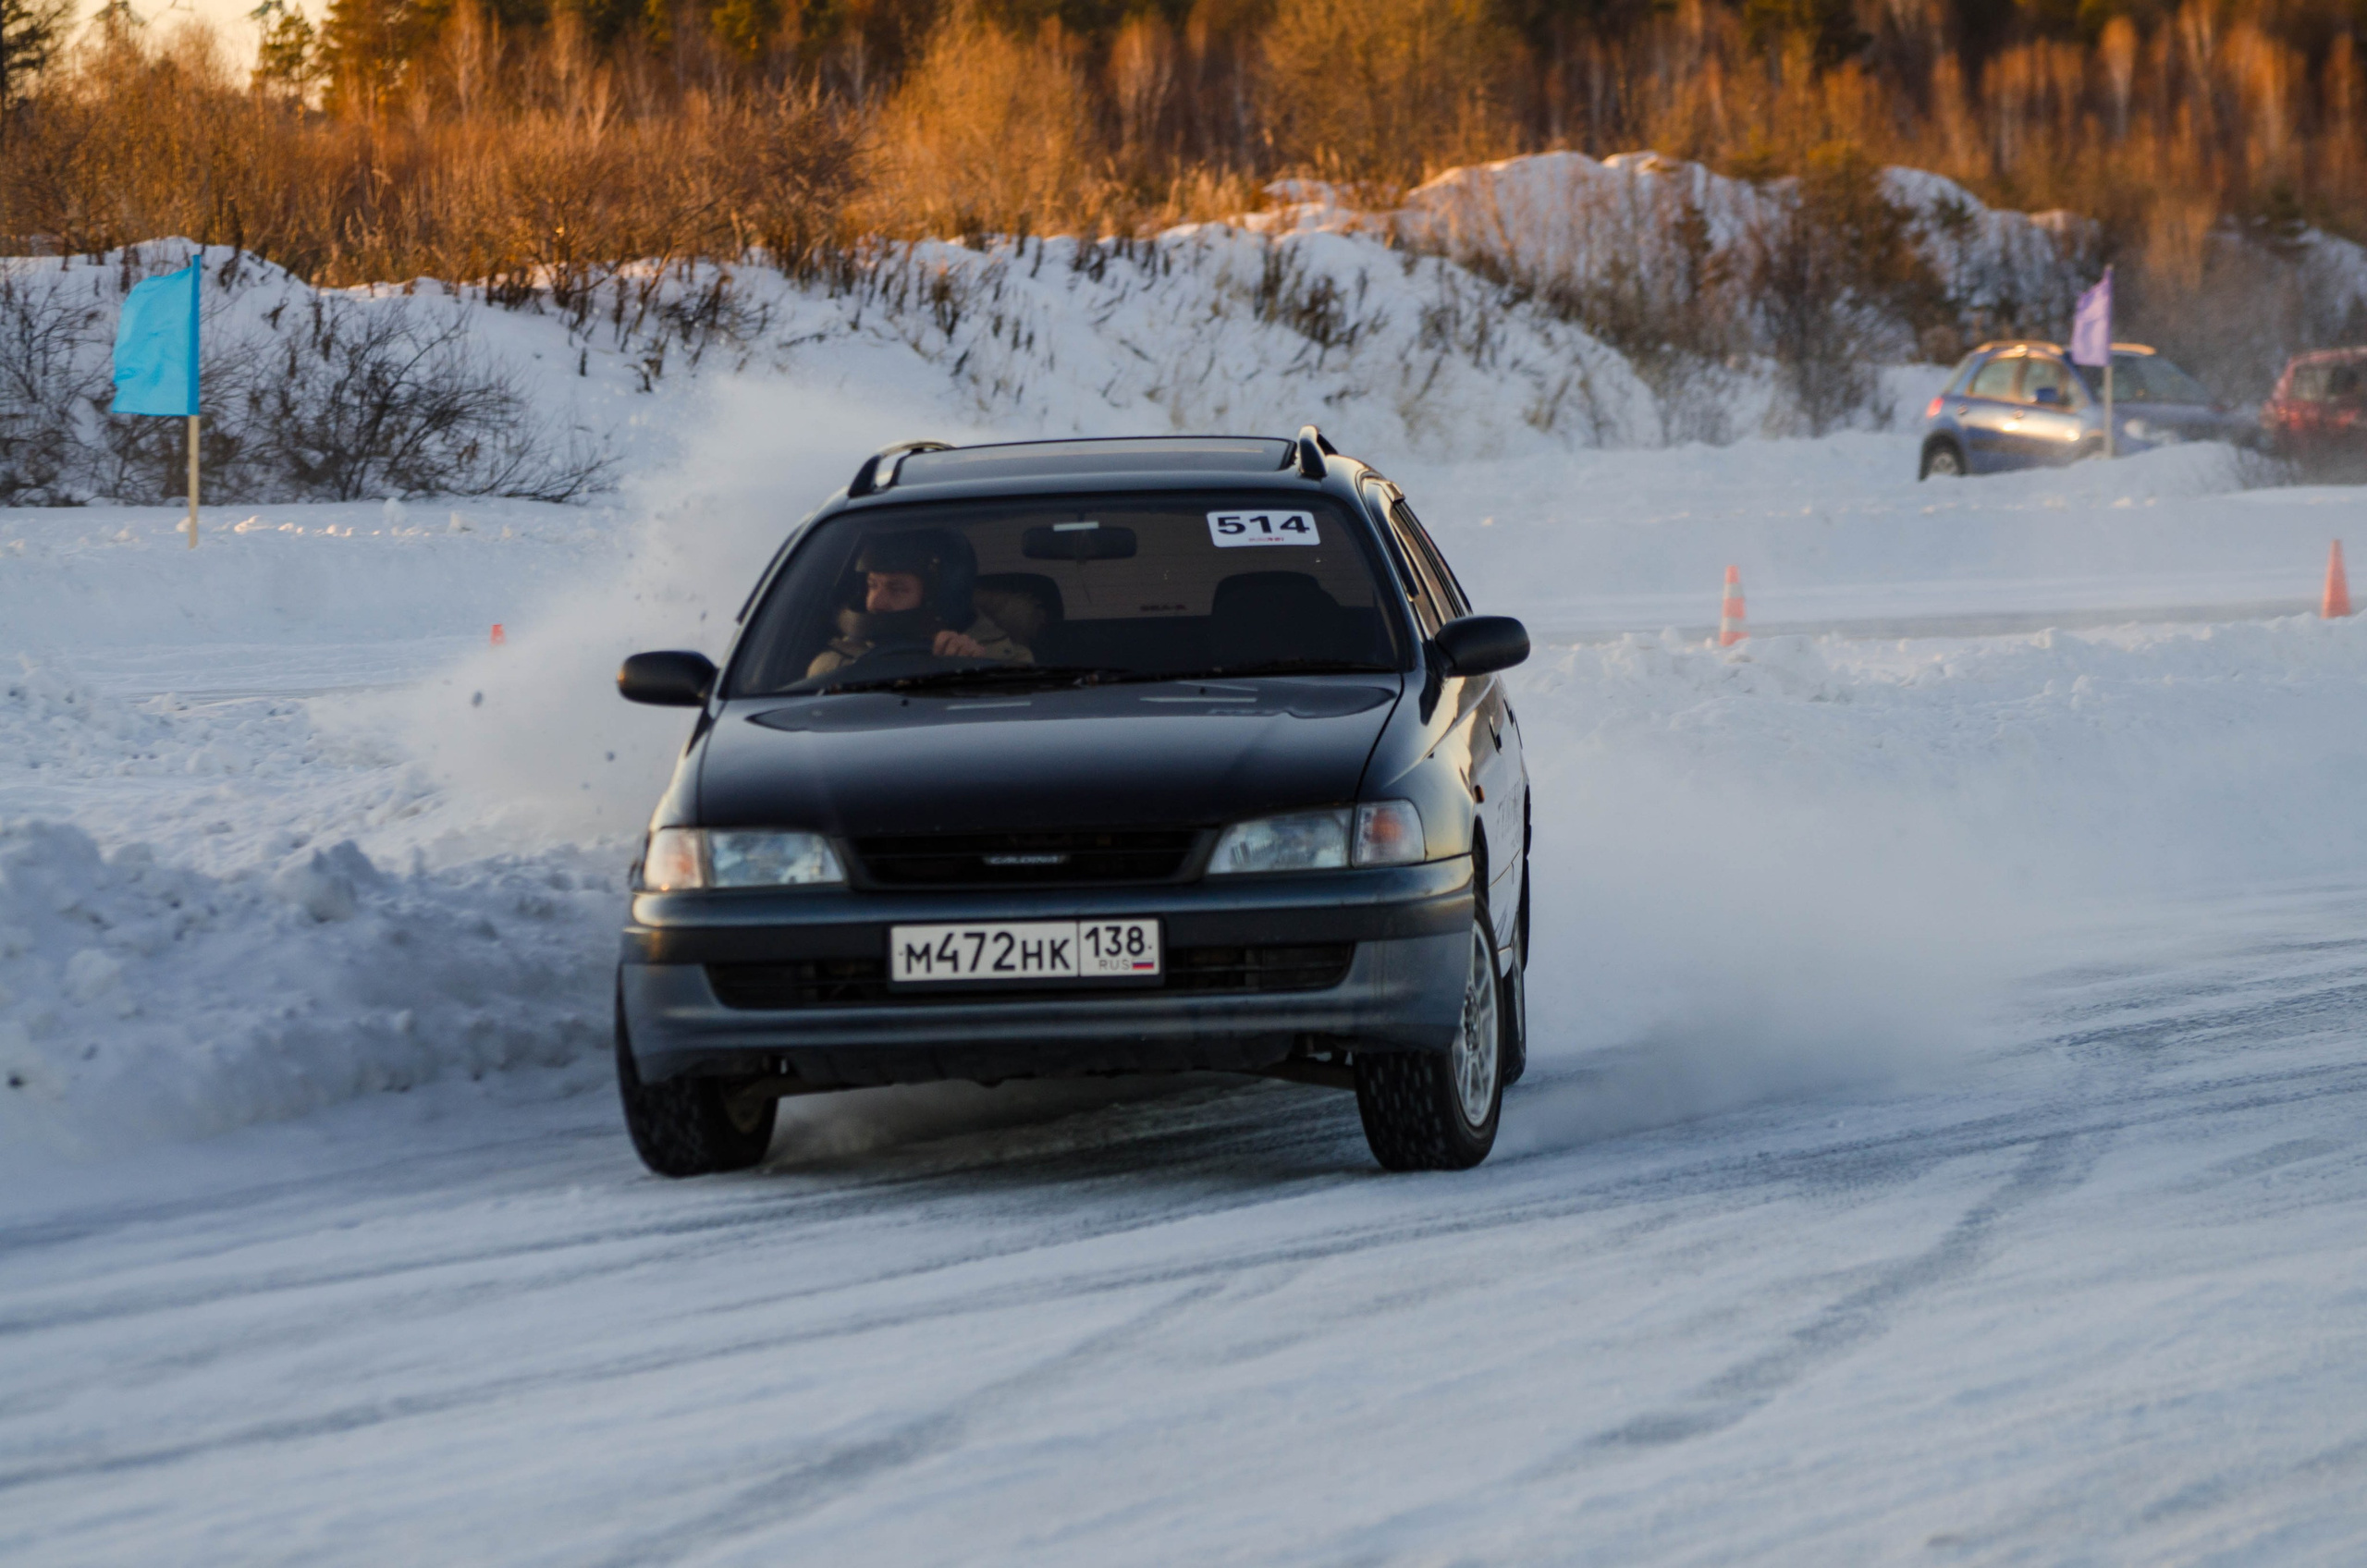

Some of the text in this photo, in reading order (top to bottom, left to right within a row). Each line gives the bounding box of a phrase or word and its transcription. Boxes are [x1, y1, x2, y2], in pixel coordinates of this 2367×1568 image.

[1218, 515, 1310, 535] 514
[1085, 926, 1146, 958] 138
[1098, 959, 1130, 971] RUS
